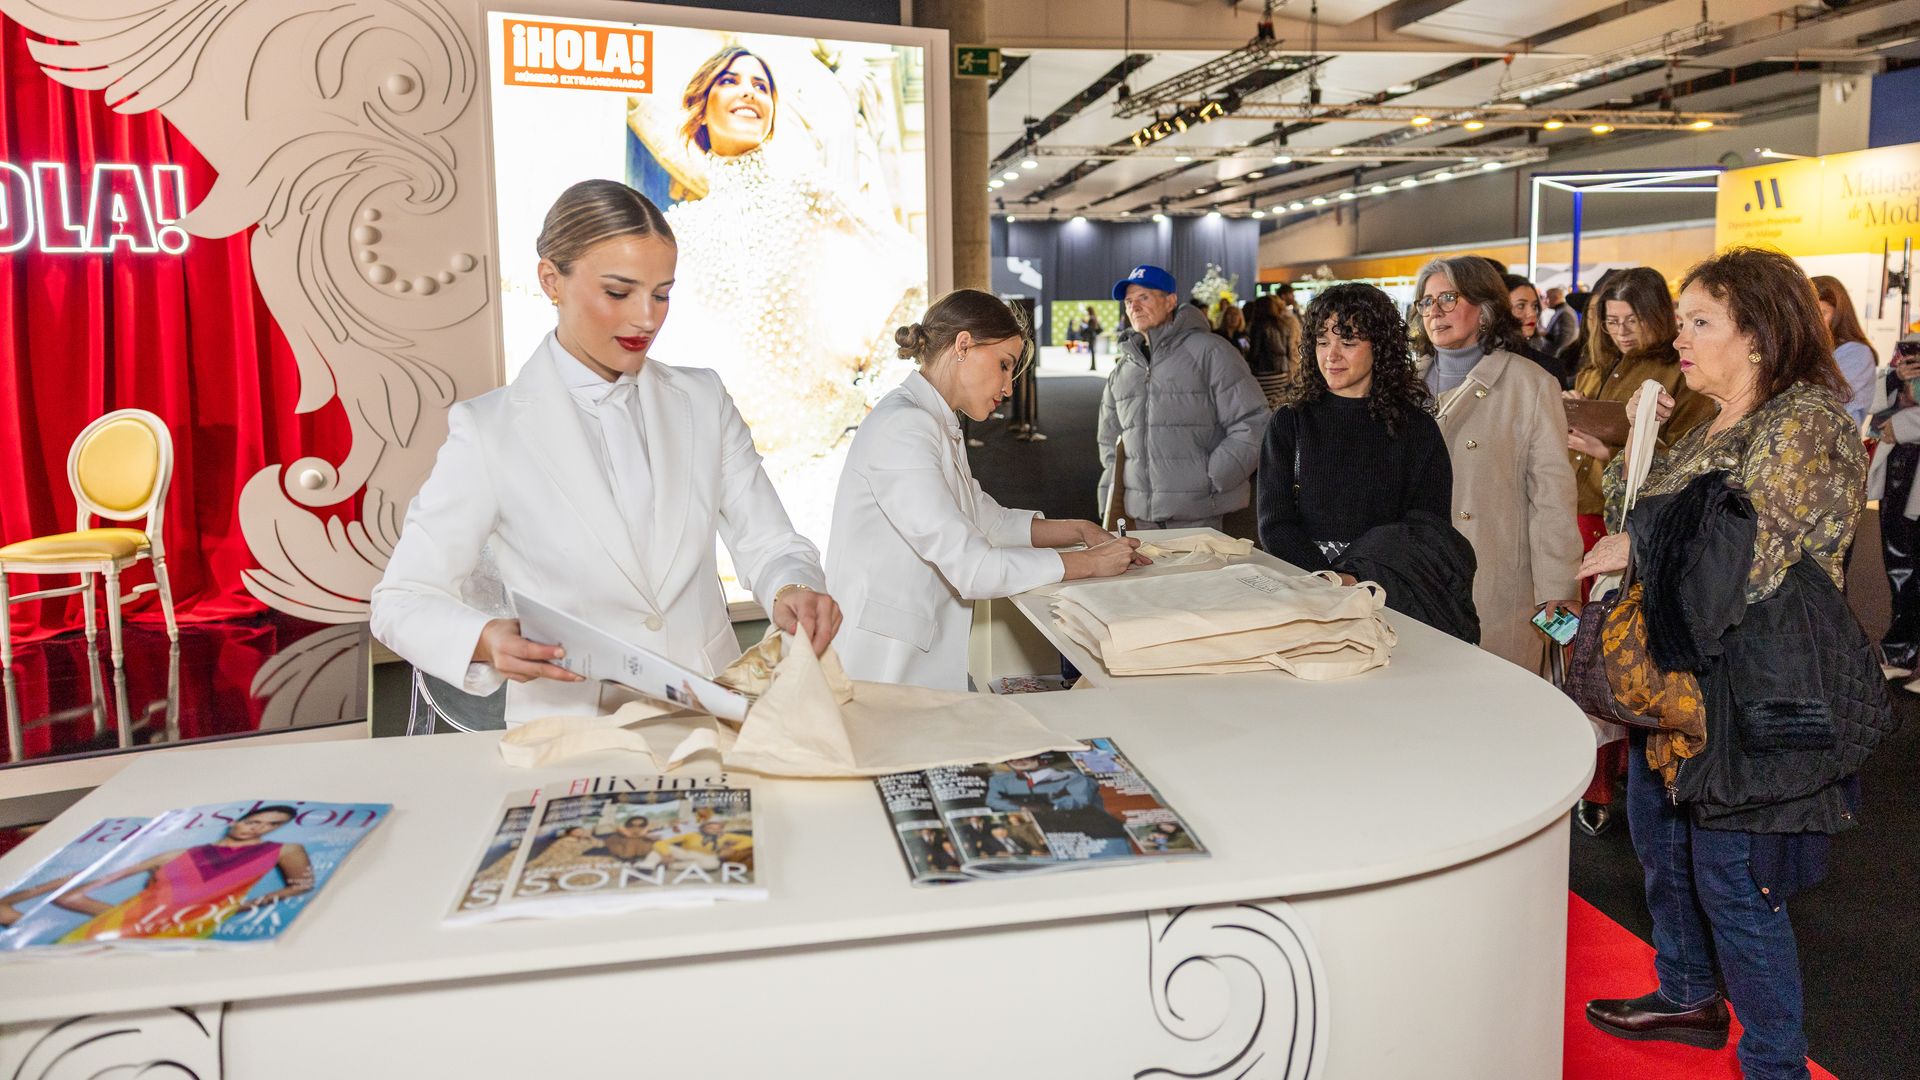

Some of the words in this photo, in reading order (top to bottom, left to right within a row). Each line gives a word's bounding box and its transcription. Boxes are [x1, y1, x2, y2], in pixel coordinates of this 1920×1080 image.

[512, 24, 645, 75] ¡HOLA!
[515, 71, 559, 84] NÚMERO
[560, 75, 646, 89] EXTRAORDINARIO
[146, 800, 377, 834] fason
